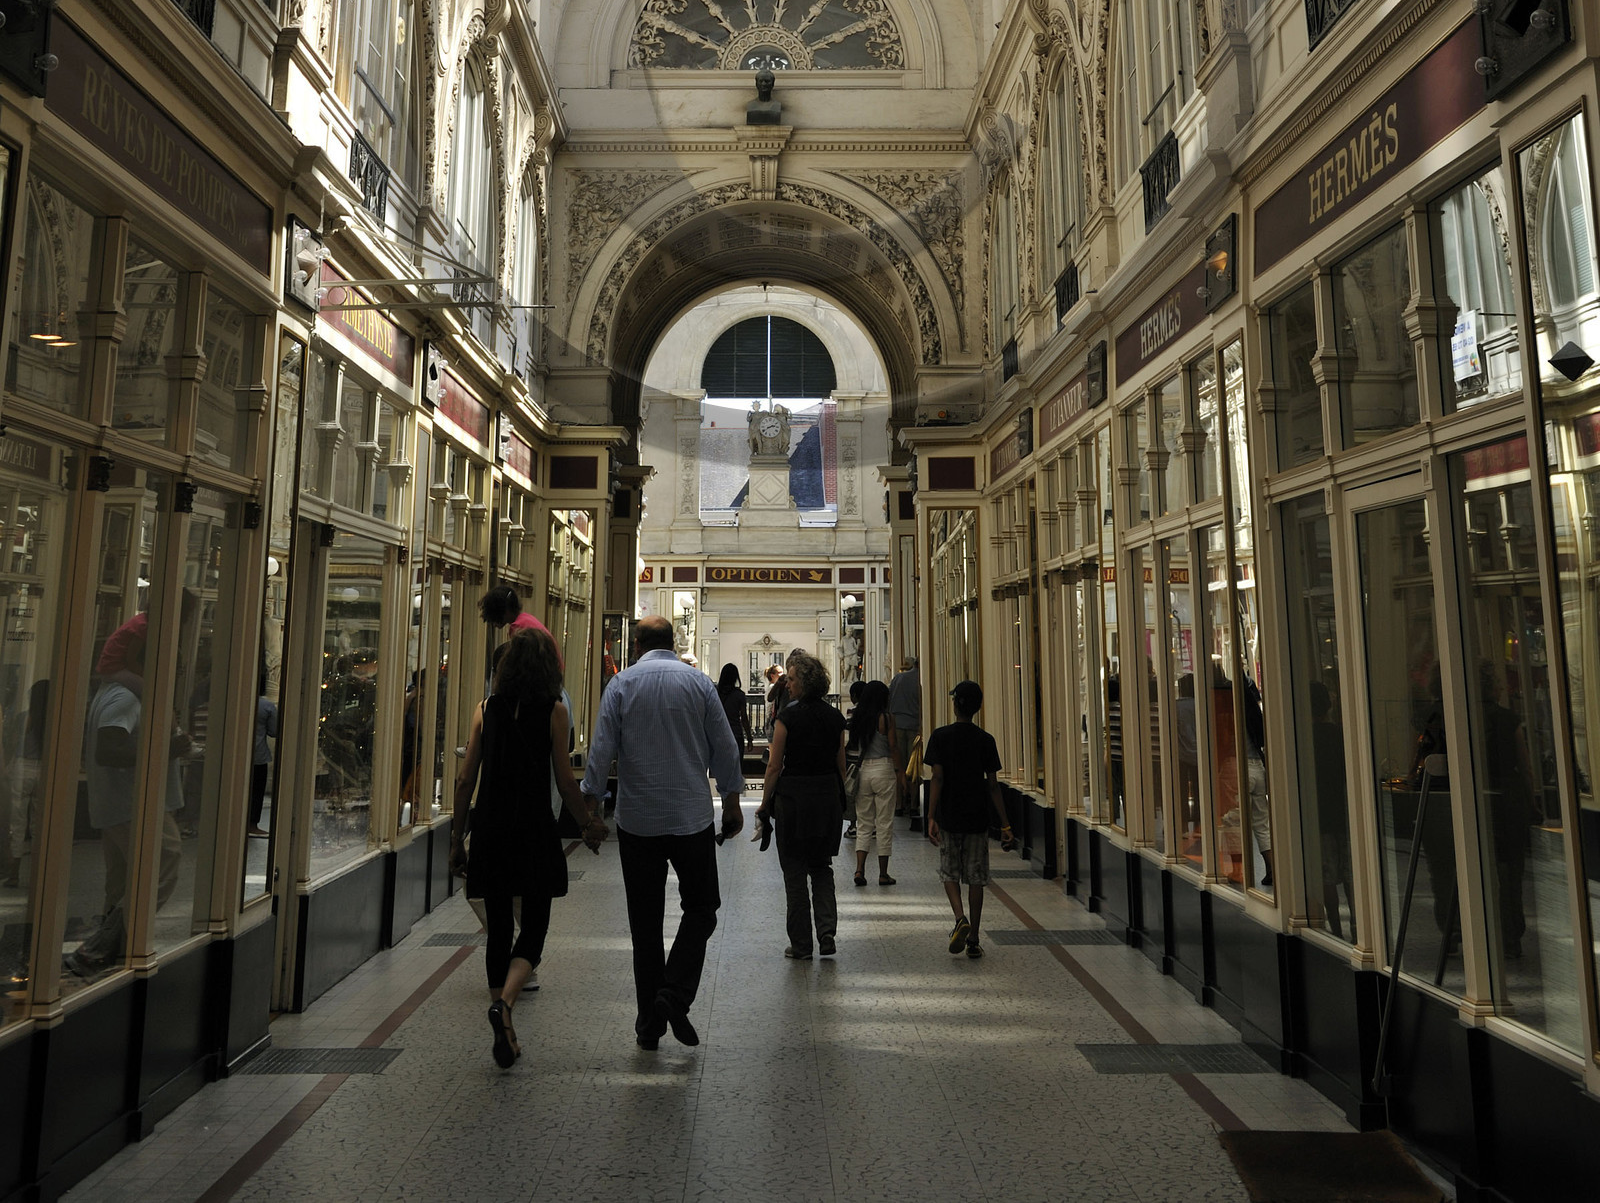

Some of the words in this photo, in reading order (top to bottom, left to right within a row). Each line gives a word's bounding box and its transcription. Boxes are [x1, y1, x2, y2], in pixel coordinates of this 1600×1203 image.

[81, 64, 149, 164] RÊVES
[150, 123, 176, 186] DE
[1308, 102, 1399, 225] HERMÈS
[1140, 291, 1183, 360] HERMÈS
[711, 568, 802, 581] OPTICIEN
